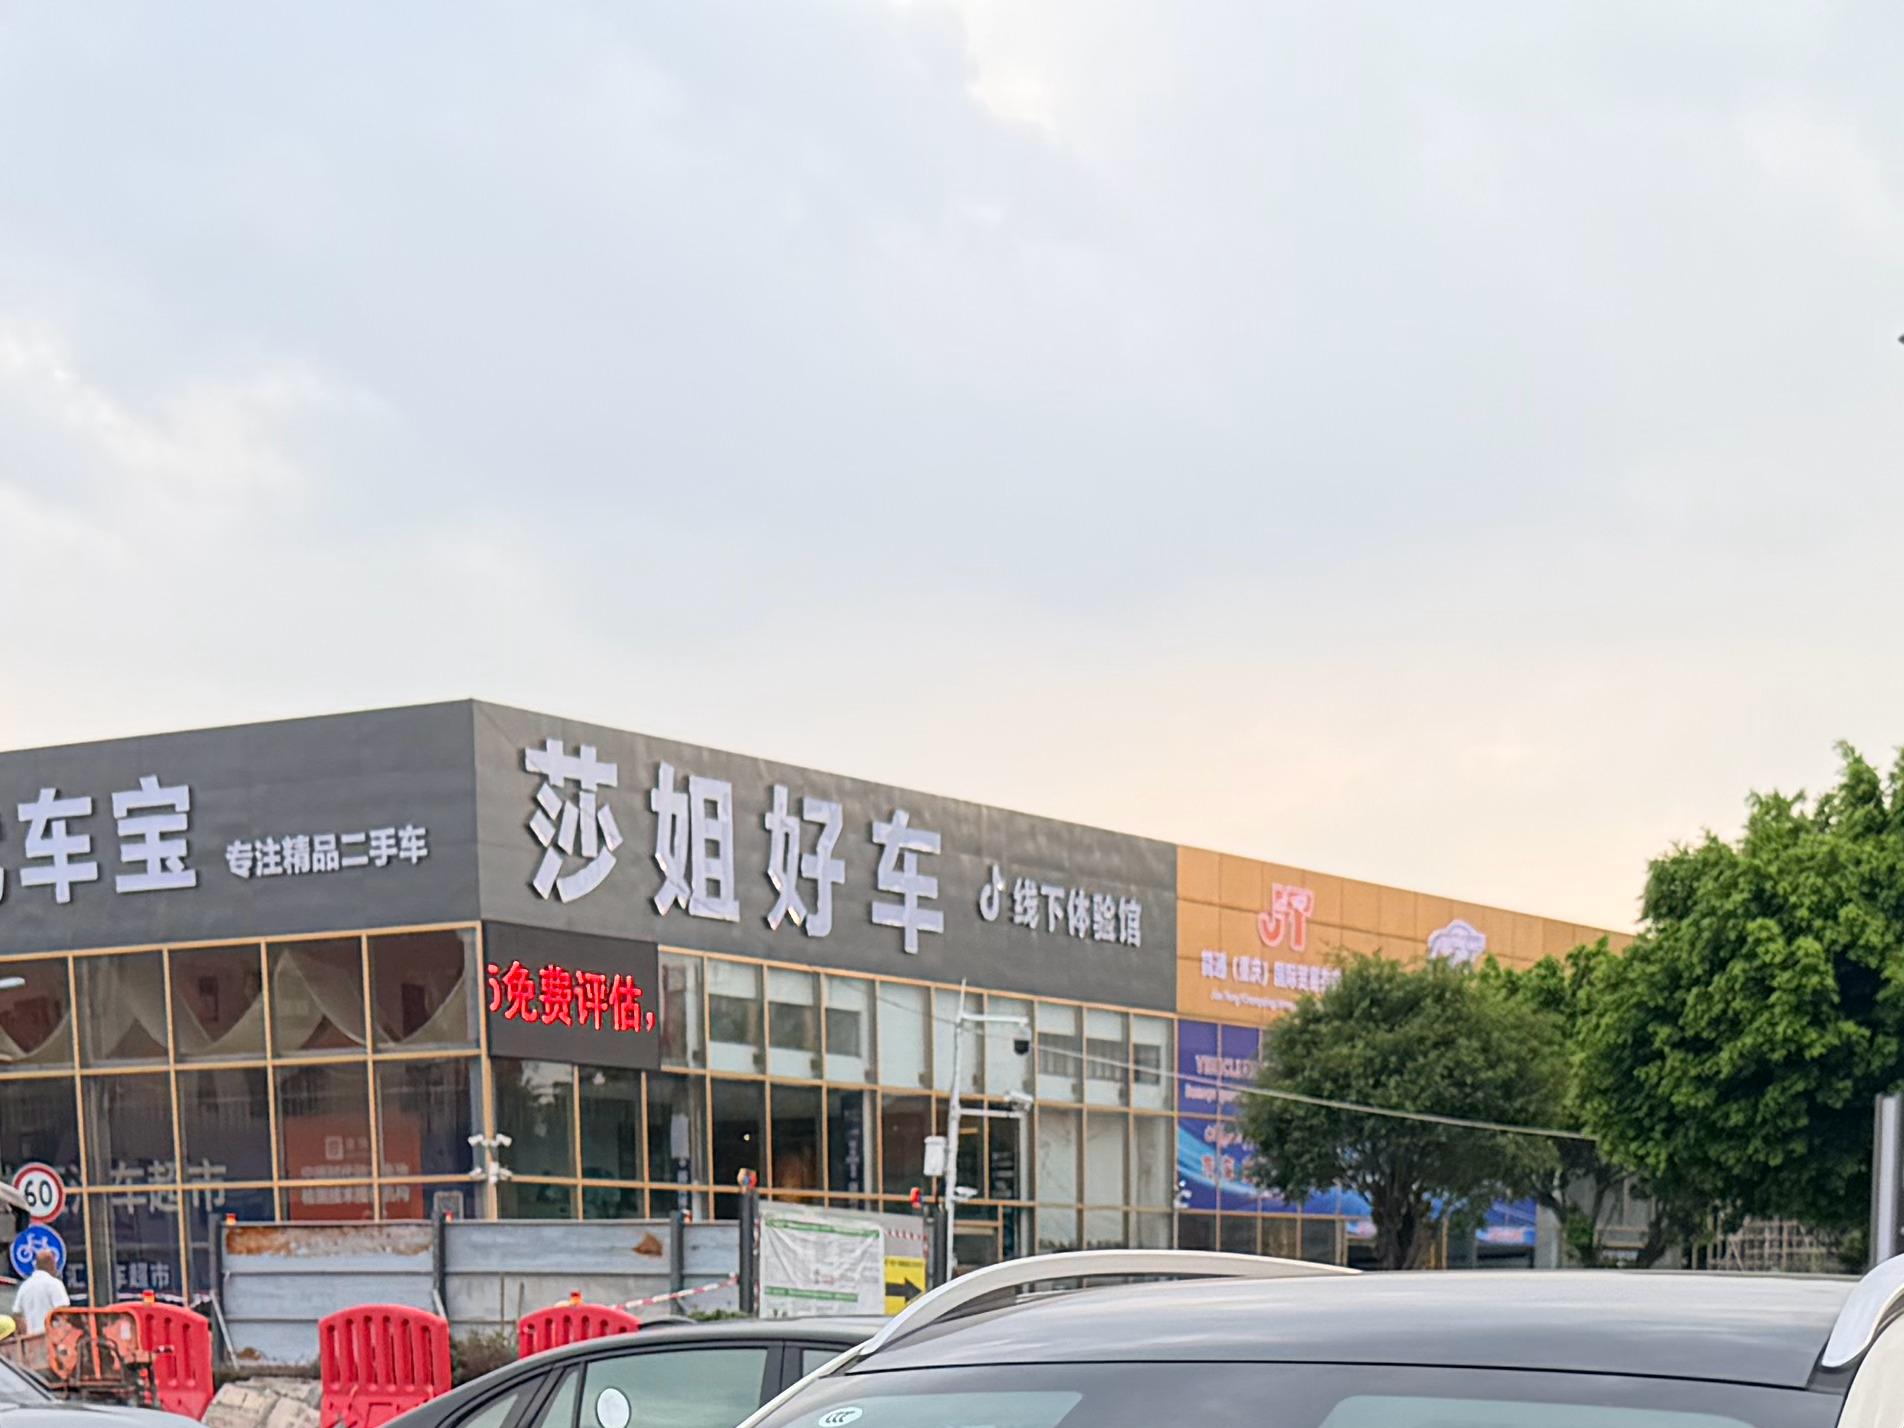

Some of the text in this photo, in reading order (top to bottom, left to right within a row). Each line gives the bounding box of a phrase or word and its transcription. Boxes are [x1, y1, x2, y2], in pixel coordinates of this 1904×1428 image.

[225, 824, 428, 878] 专注精品二手车
[525, 738, 944, 954] 莎姐好车
[1012, 877, 1142, 948] 线下体验馆
[24, 1180, 53, 1208] 60
